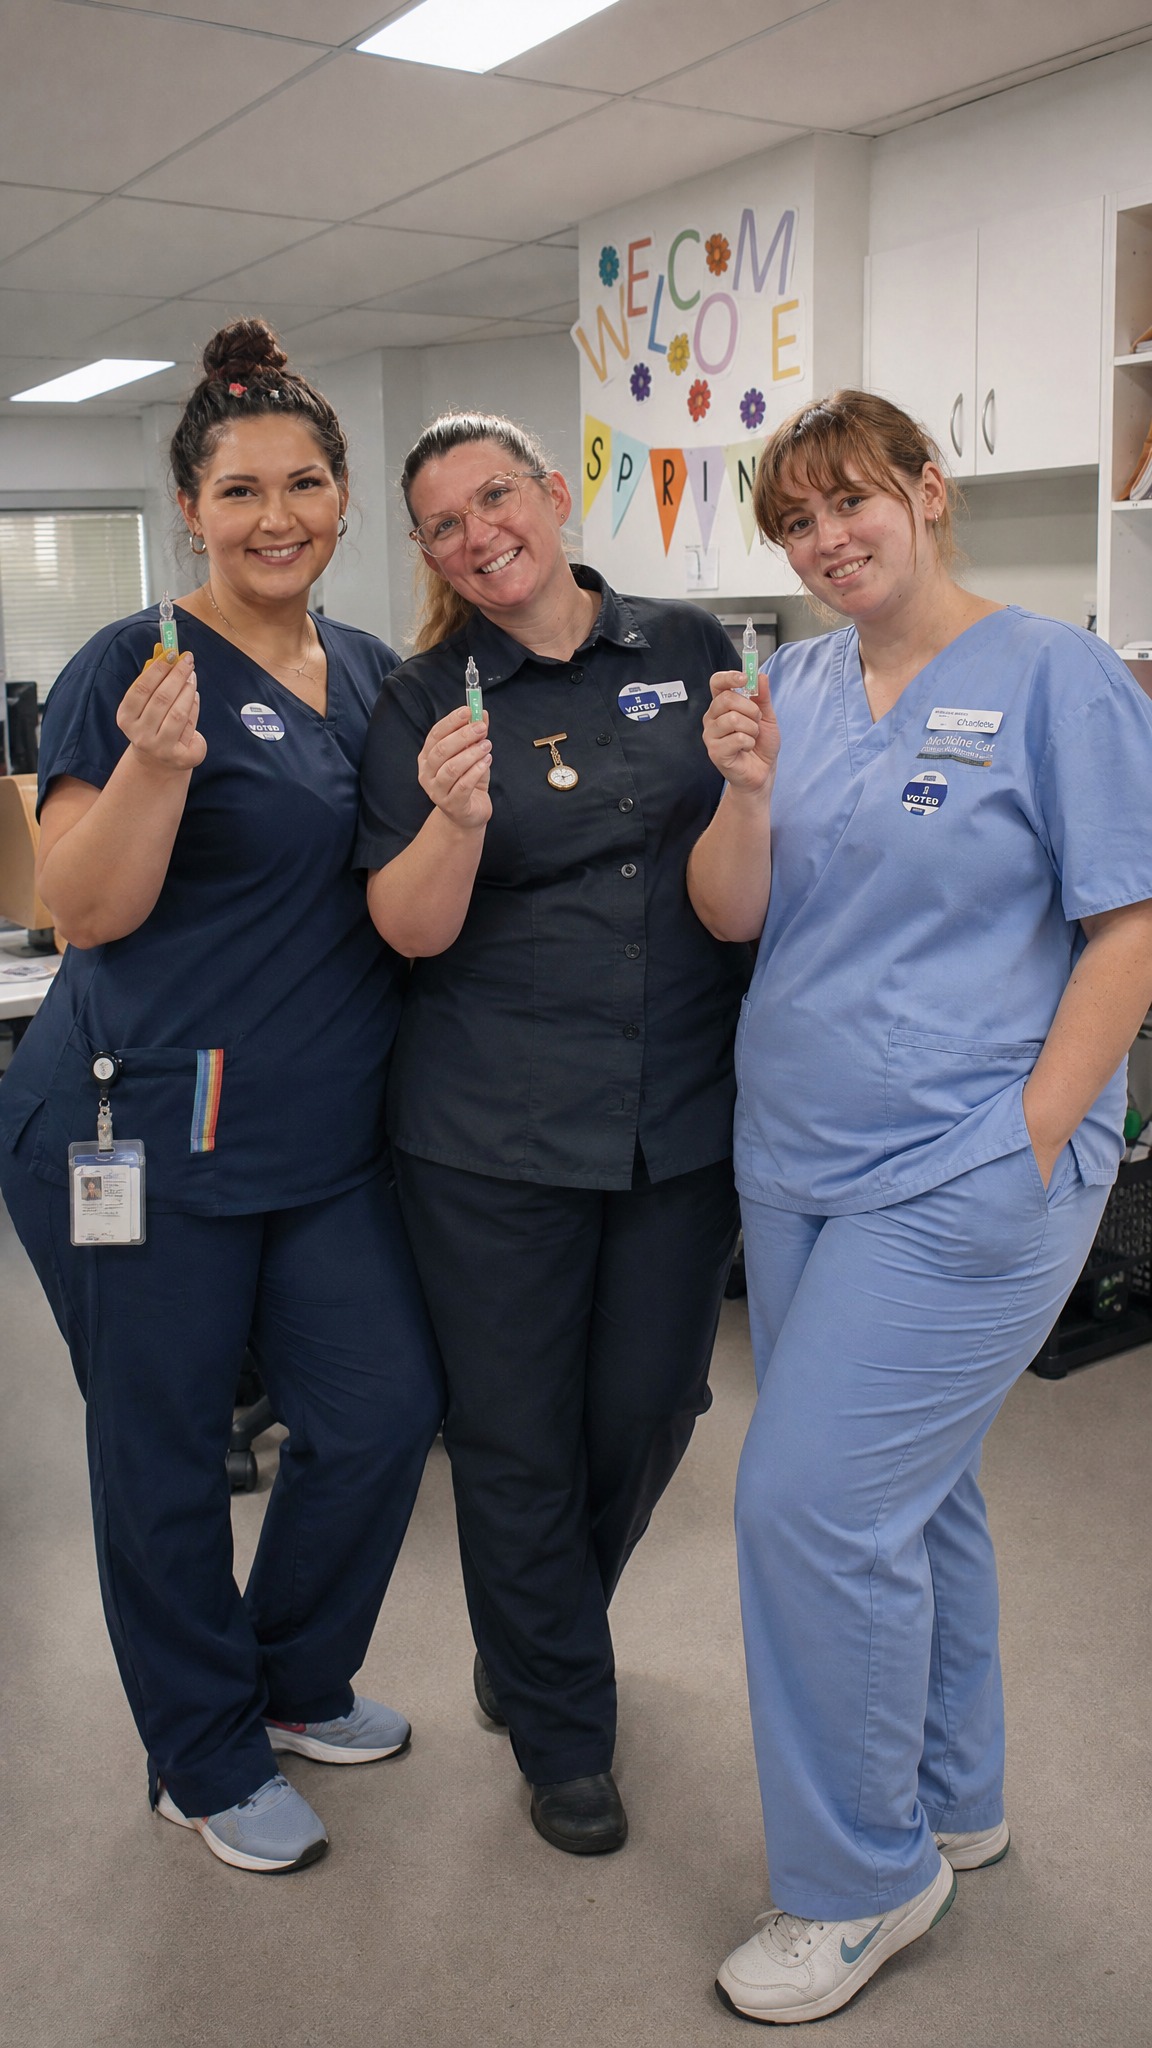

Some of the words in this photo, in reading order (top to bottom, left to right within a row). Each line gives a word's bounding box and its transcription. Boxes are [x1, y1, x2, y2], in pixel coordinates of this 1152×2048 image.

[576, 208, 800, 382] WELCOME
[587, 437, 756, 505] SPRIN
[625, 702, 656, 713] VOTED
[906, 794, 939, 806] VOTED
